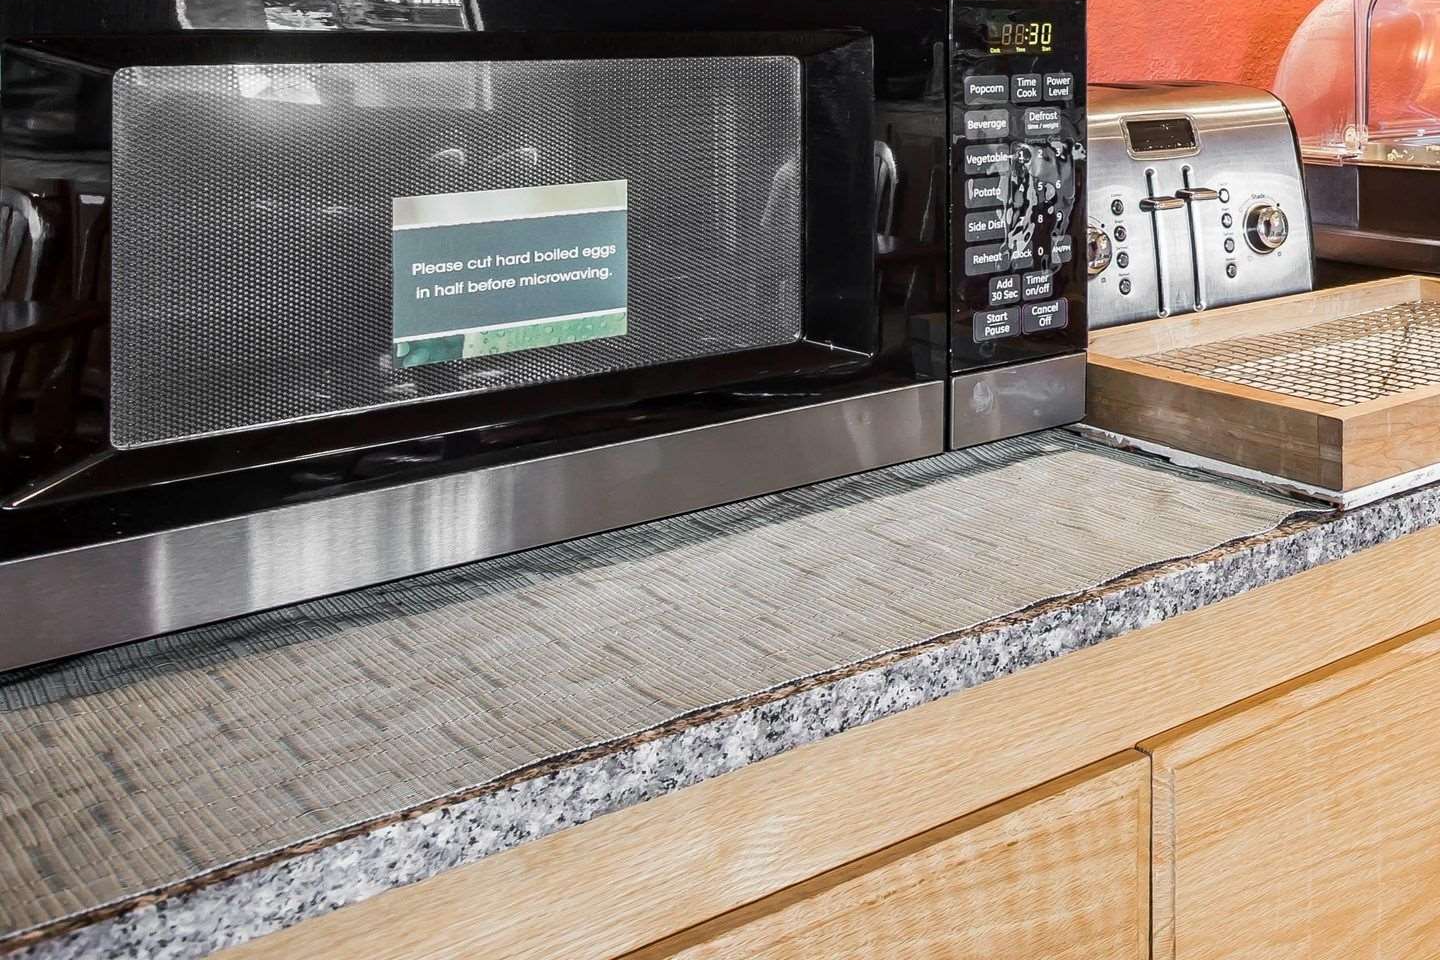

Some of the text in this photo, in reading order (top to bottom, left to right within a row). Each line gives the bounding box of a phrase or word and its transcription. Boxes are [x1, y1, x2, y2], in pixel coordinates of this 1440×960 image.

[1016, 77, 1037, 87] Time
[1046, 76, 1071, 86] Power
[970, 84, 1004, 96] Popcorn
[1016, 88, 1037, 98] Cook
[1048, 86, 1069, 96] Level
[1029, 110, 1058, 121] Defrost
[967, 120, 1007, 131] Beverage
[1018, 151, 1024, 161] 1
[1037, 149, 1043, 158] 2
[1055, 148, 1061, 157] 3
[966, 152, 1008, 166] Vegetable
[1018, 183, 1025, 193] 4
[1037, 182, 1043, 191] 5
[1055, 180, 1061, 189] 6
[973, 187, 1001, 198] Potato
[1037, 214, 1043, 223] 8
[1056, 212, 1062, 221] 9
[968, 219, 1006, 232] Side Dish
[1037, 246, 1044, 256] 0
[412, 243, 617, 276] Please cut hard boiled eggs
[973, 252, 1002, 264] Reheat
[415, 266, 613, 300] in half before microwaving.
[996, 278, 1013, 290] Add
[1026, 274, 1049, 285] Timer
[1025, 283, 1050, 296] on/off
[991, 289, 1019, 302] 30 Sec
[1031, 302, 1059, 315] Cancel
[986, 311, 1009, 324] Start
[1039, 316, 1052, 326] Off
[984, 324, 1010, 337] Pause
